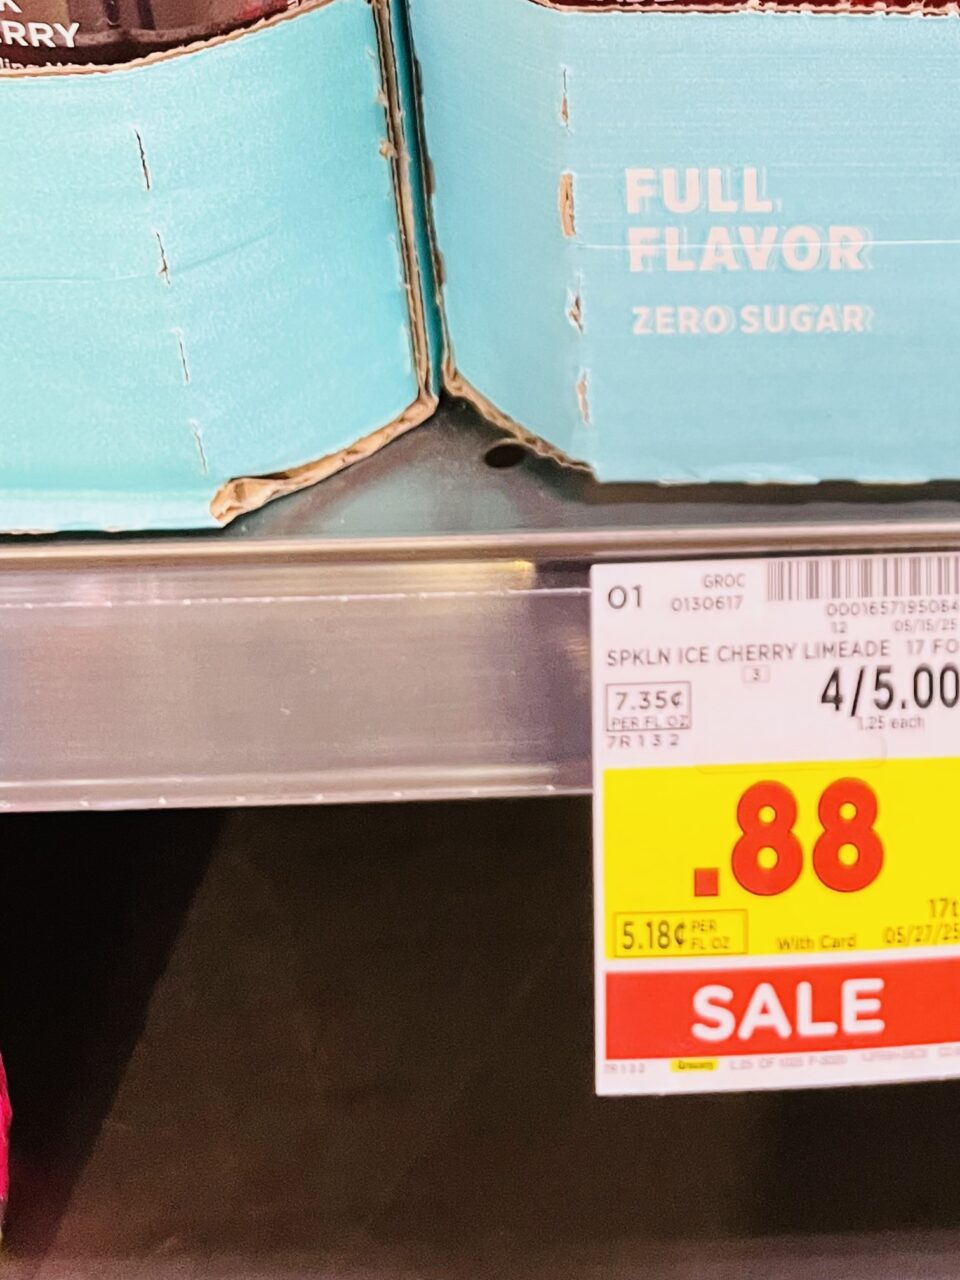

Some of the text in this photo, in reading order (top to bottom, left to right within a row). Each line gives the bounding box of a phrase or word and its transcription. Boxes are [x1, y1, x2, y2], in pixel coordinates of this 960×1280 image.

[625, 167, 773, 214] FULL
[628, 225, 866, 272] FLAVOR
[632, 304, 866, 335] ZERO SUGAR
[703, 573, 746, 589] GROC
[672, 595, 743, 611] 0130617
[607, 648, 670, 667] SPKLN
[678, 646, 709, 664] ICE
[717, 643, 796, 662] CHERRY
[804, 640, 890, 659] LIMEADE
[906, 640, 925, 655] 17
[820, 663, 960, 717] 4/5.00
[611, 717, 638, 730] PER
[891, 715, 925, 730] each
[693, 777, 884, 897] .88
[691, 920, 717, 932] PER
[777, 935, 815, 950] With
[820, 934, 857, 948] Card
[691, 978, 885, 1042] SALE
